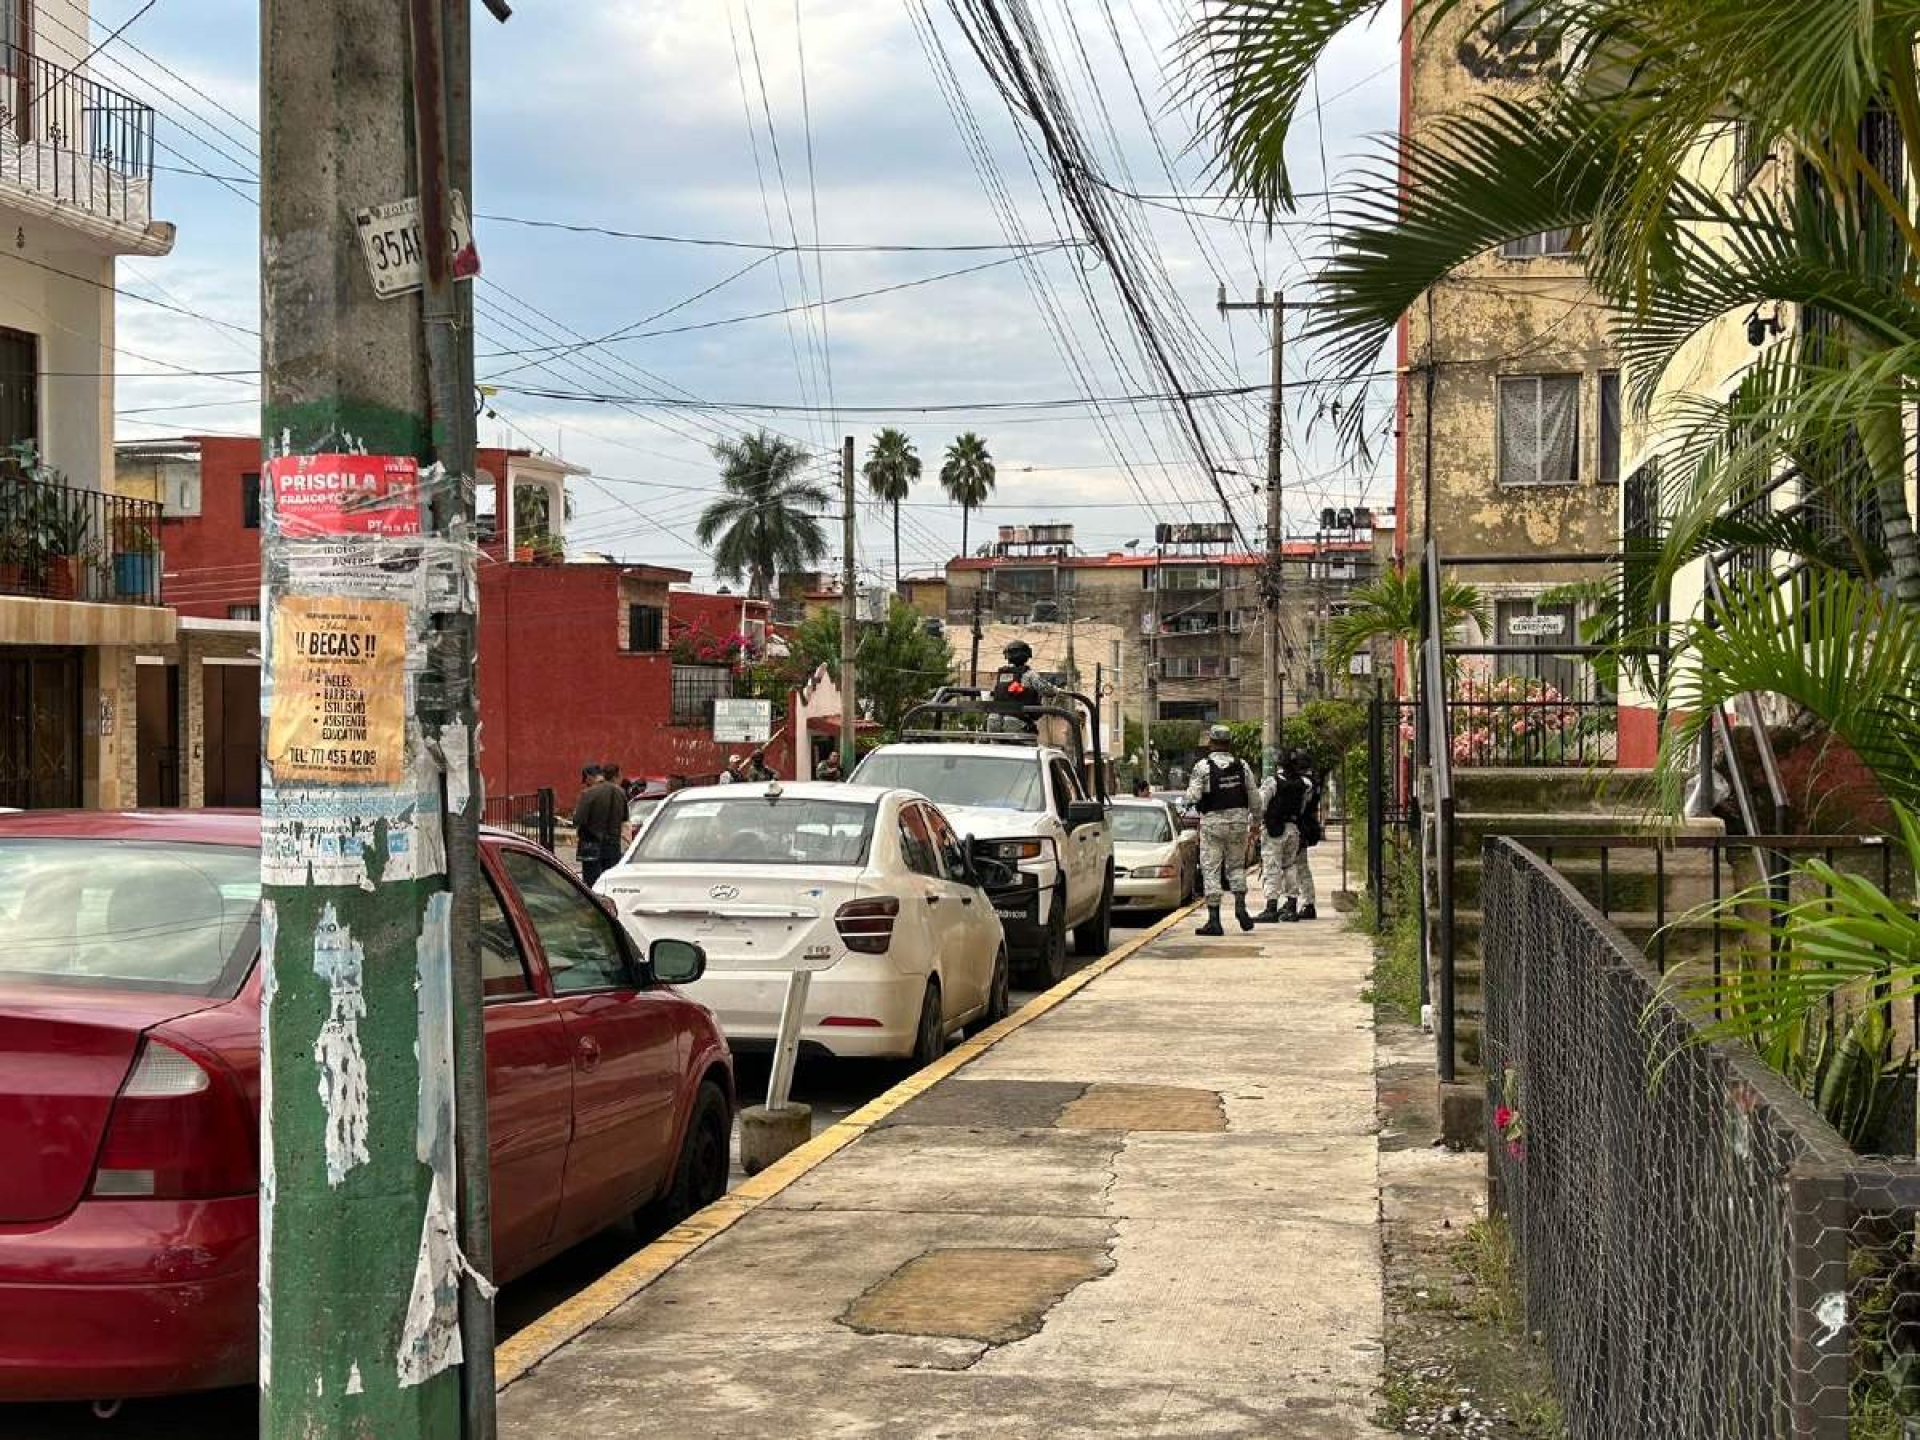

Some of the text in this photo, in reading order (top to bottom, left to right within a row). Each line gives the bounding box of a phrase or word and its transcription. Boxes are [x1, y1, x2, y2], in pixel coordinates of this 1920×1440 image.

[372, 224, 422, 270] 35A
[281, 472, 377, 492] PRISCILA
[309, 633, 360, 657] BECAS
[324, 701, 366, 714] ESTILISMO
[322, 715, 367, 727] ASISTENTE
[322, 728, 367, 741] EDUCATIVO
[327, 750, 346, 765] 455
